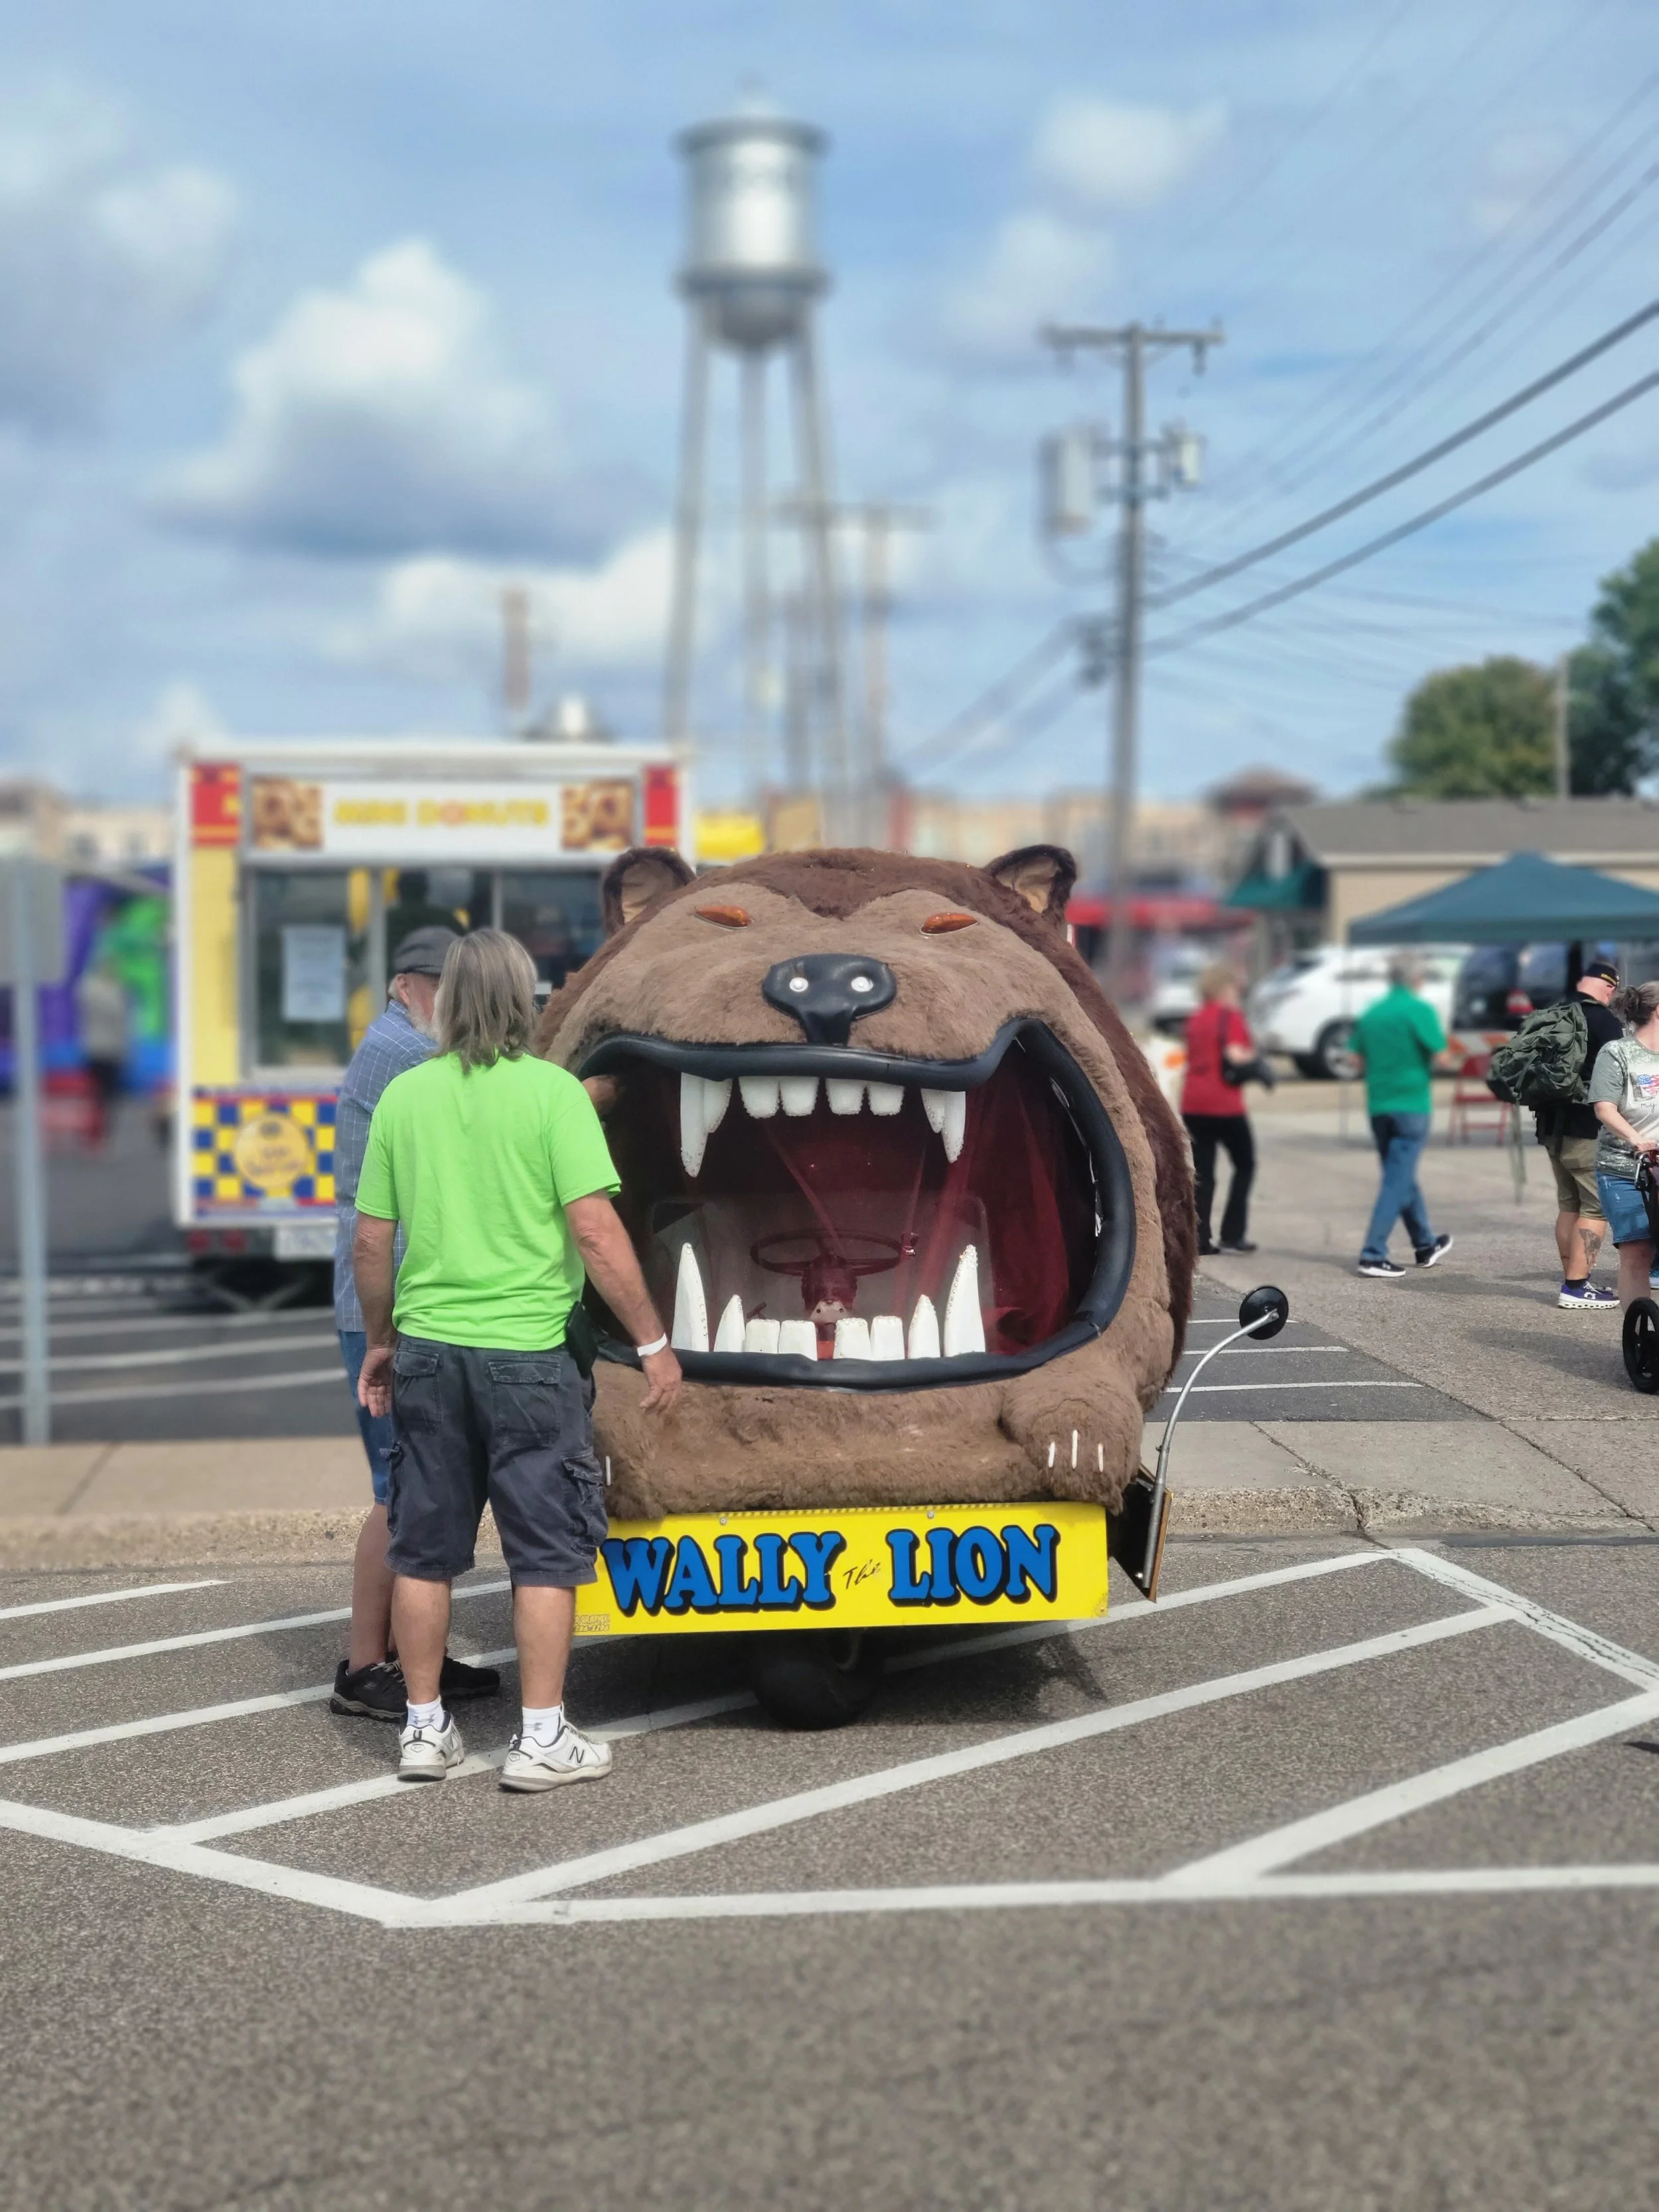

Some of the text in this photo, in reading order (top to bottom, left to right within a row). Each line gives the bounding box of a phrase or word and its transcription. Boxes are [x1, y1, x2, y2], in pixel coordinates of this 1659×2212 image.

[601, 1524, 1060, 1617] WALLY The LION
